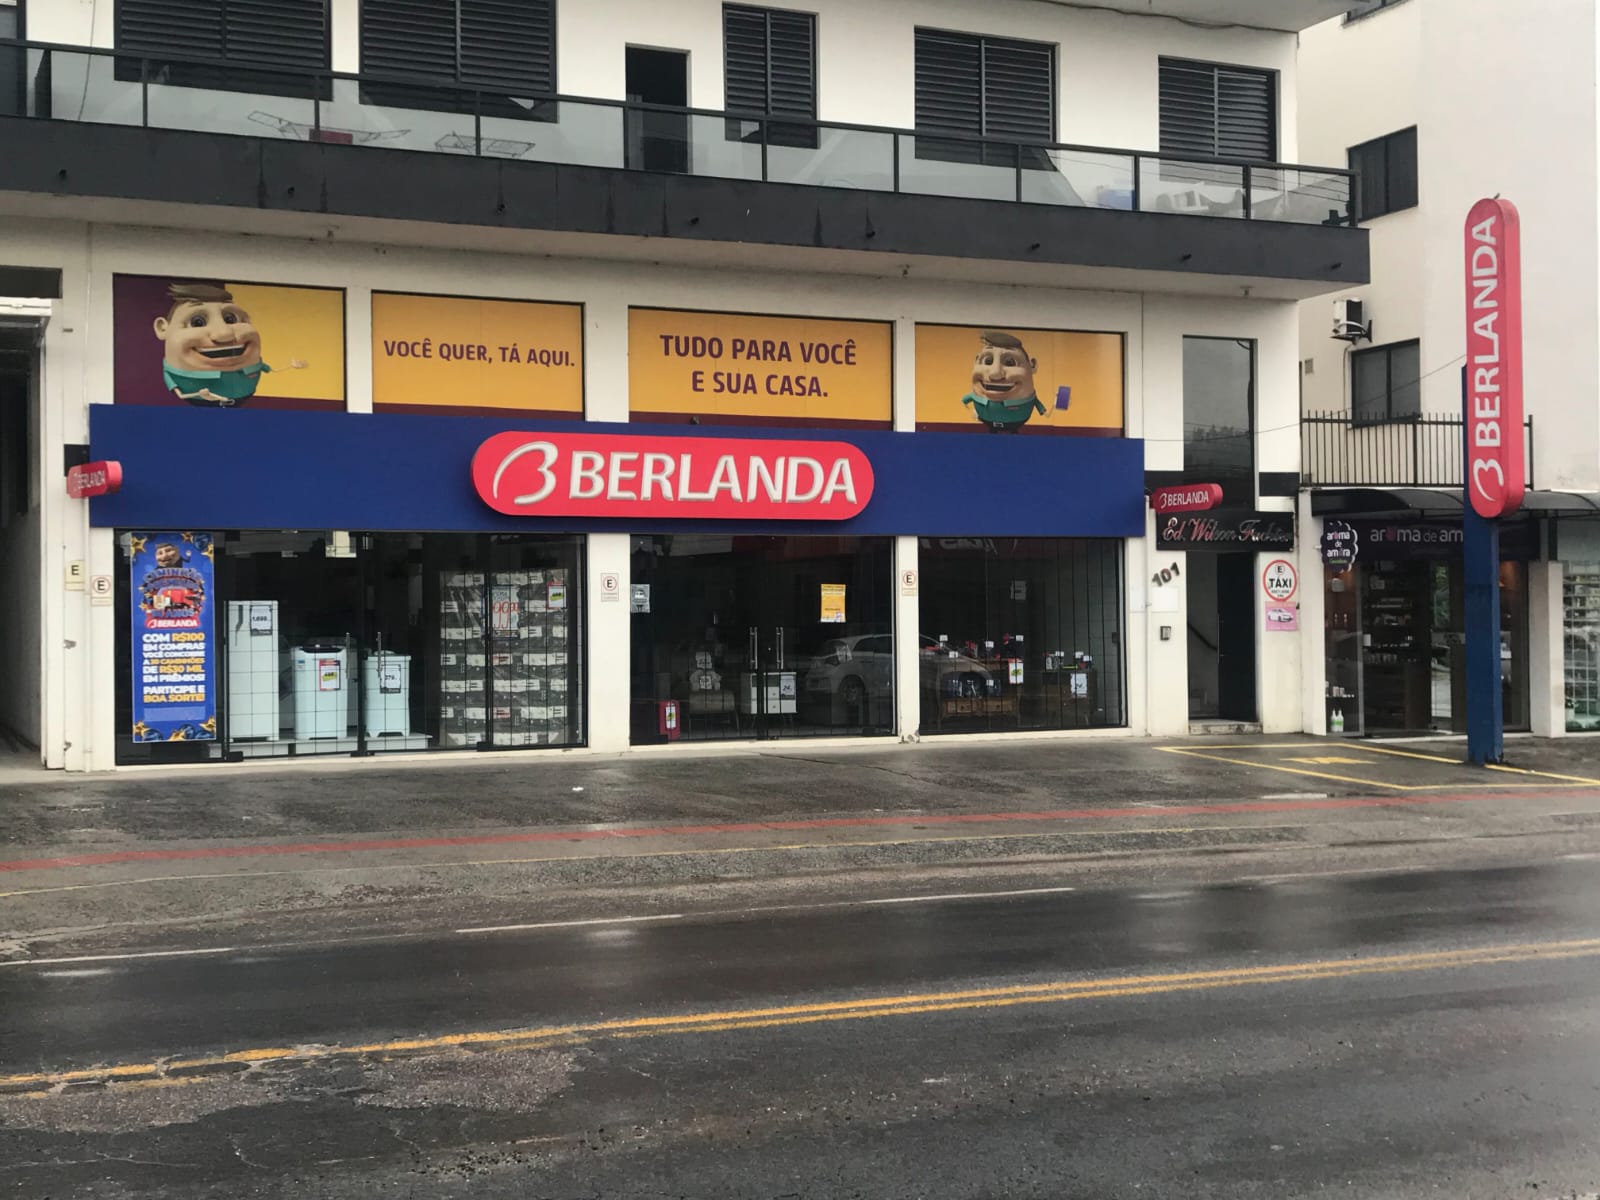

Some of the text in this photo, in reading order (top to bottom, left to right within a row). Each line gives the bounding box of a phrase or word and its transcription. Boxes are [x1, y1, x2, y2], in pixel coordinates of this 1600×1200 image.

[1471, 215, 1501, 448] BERLANDA
[383, 338, 575, 367] VOCÊ QUER, TÁ AQUI.
[659, 334, 857, 366] TUDO PARA VOCÊ
[692, 370, 828, 397] E SUA CASA.
[568, 450, 858, 505] BERLANDA
[1167, 490, 1210, 507] BERLANDA
[1326, 531, 1350, 541] aroma
[1370, 528, 1464, 543] aroma de am
[71, 564, 80, 576] E
[1152, 562, 1181, 587] 101
[606, 579, 613, 588] E
[906, 574, 913, 584] E
[97, 580, 106, 591] E
[157, 618, 199, 628] BERLANDA
[142, 633, 170, 643] COM
[143, 642, 206, 651] EM COMPRAS
[143, 665, 158, 674] DE
[143, 674, 158, 682] EM
[143, 684, 206, 695] PARTICIPE E
[143, 694, 167, 703] BOA
